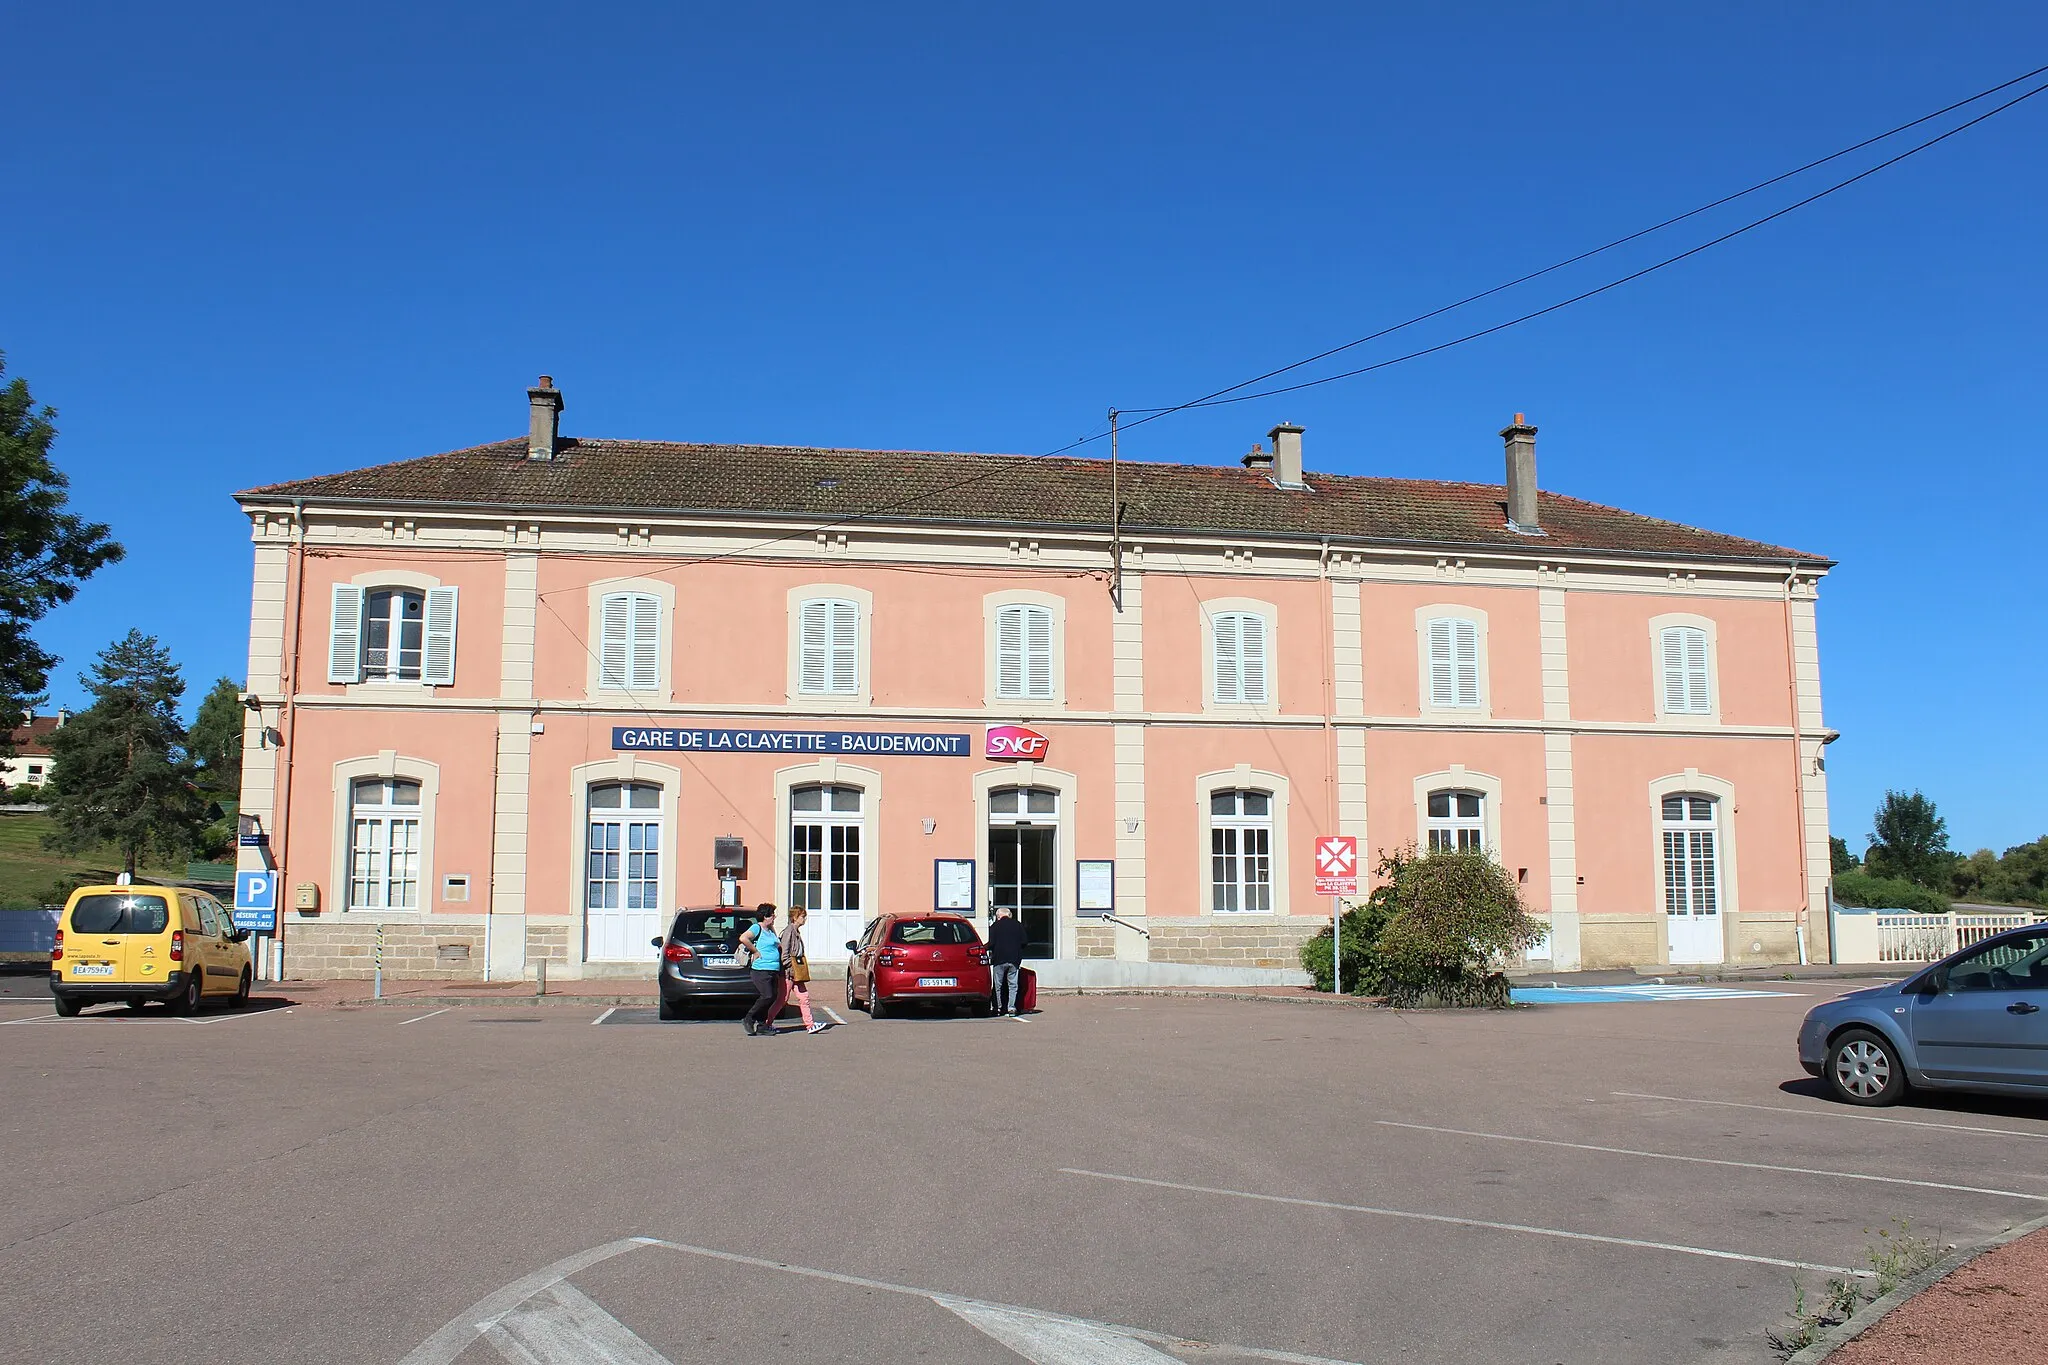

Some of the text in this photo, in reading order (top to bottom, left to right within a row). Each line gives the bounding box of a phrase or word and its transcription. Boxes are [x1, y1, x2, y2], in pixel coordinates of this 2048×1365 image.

[622, 730, 674, 747] GARE
[678, 731, 703, 748] DE
[708, 732, 732, 748] LA
[735, 732, 826, 750] CLAYETTE
[842, 734, 961, 752] BAUDEMONT
[988, 736, 1046, 754] SNCF
[247, 877, 267, 903] P
